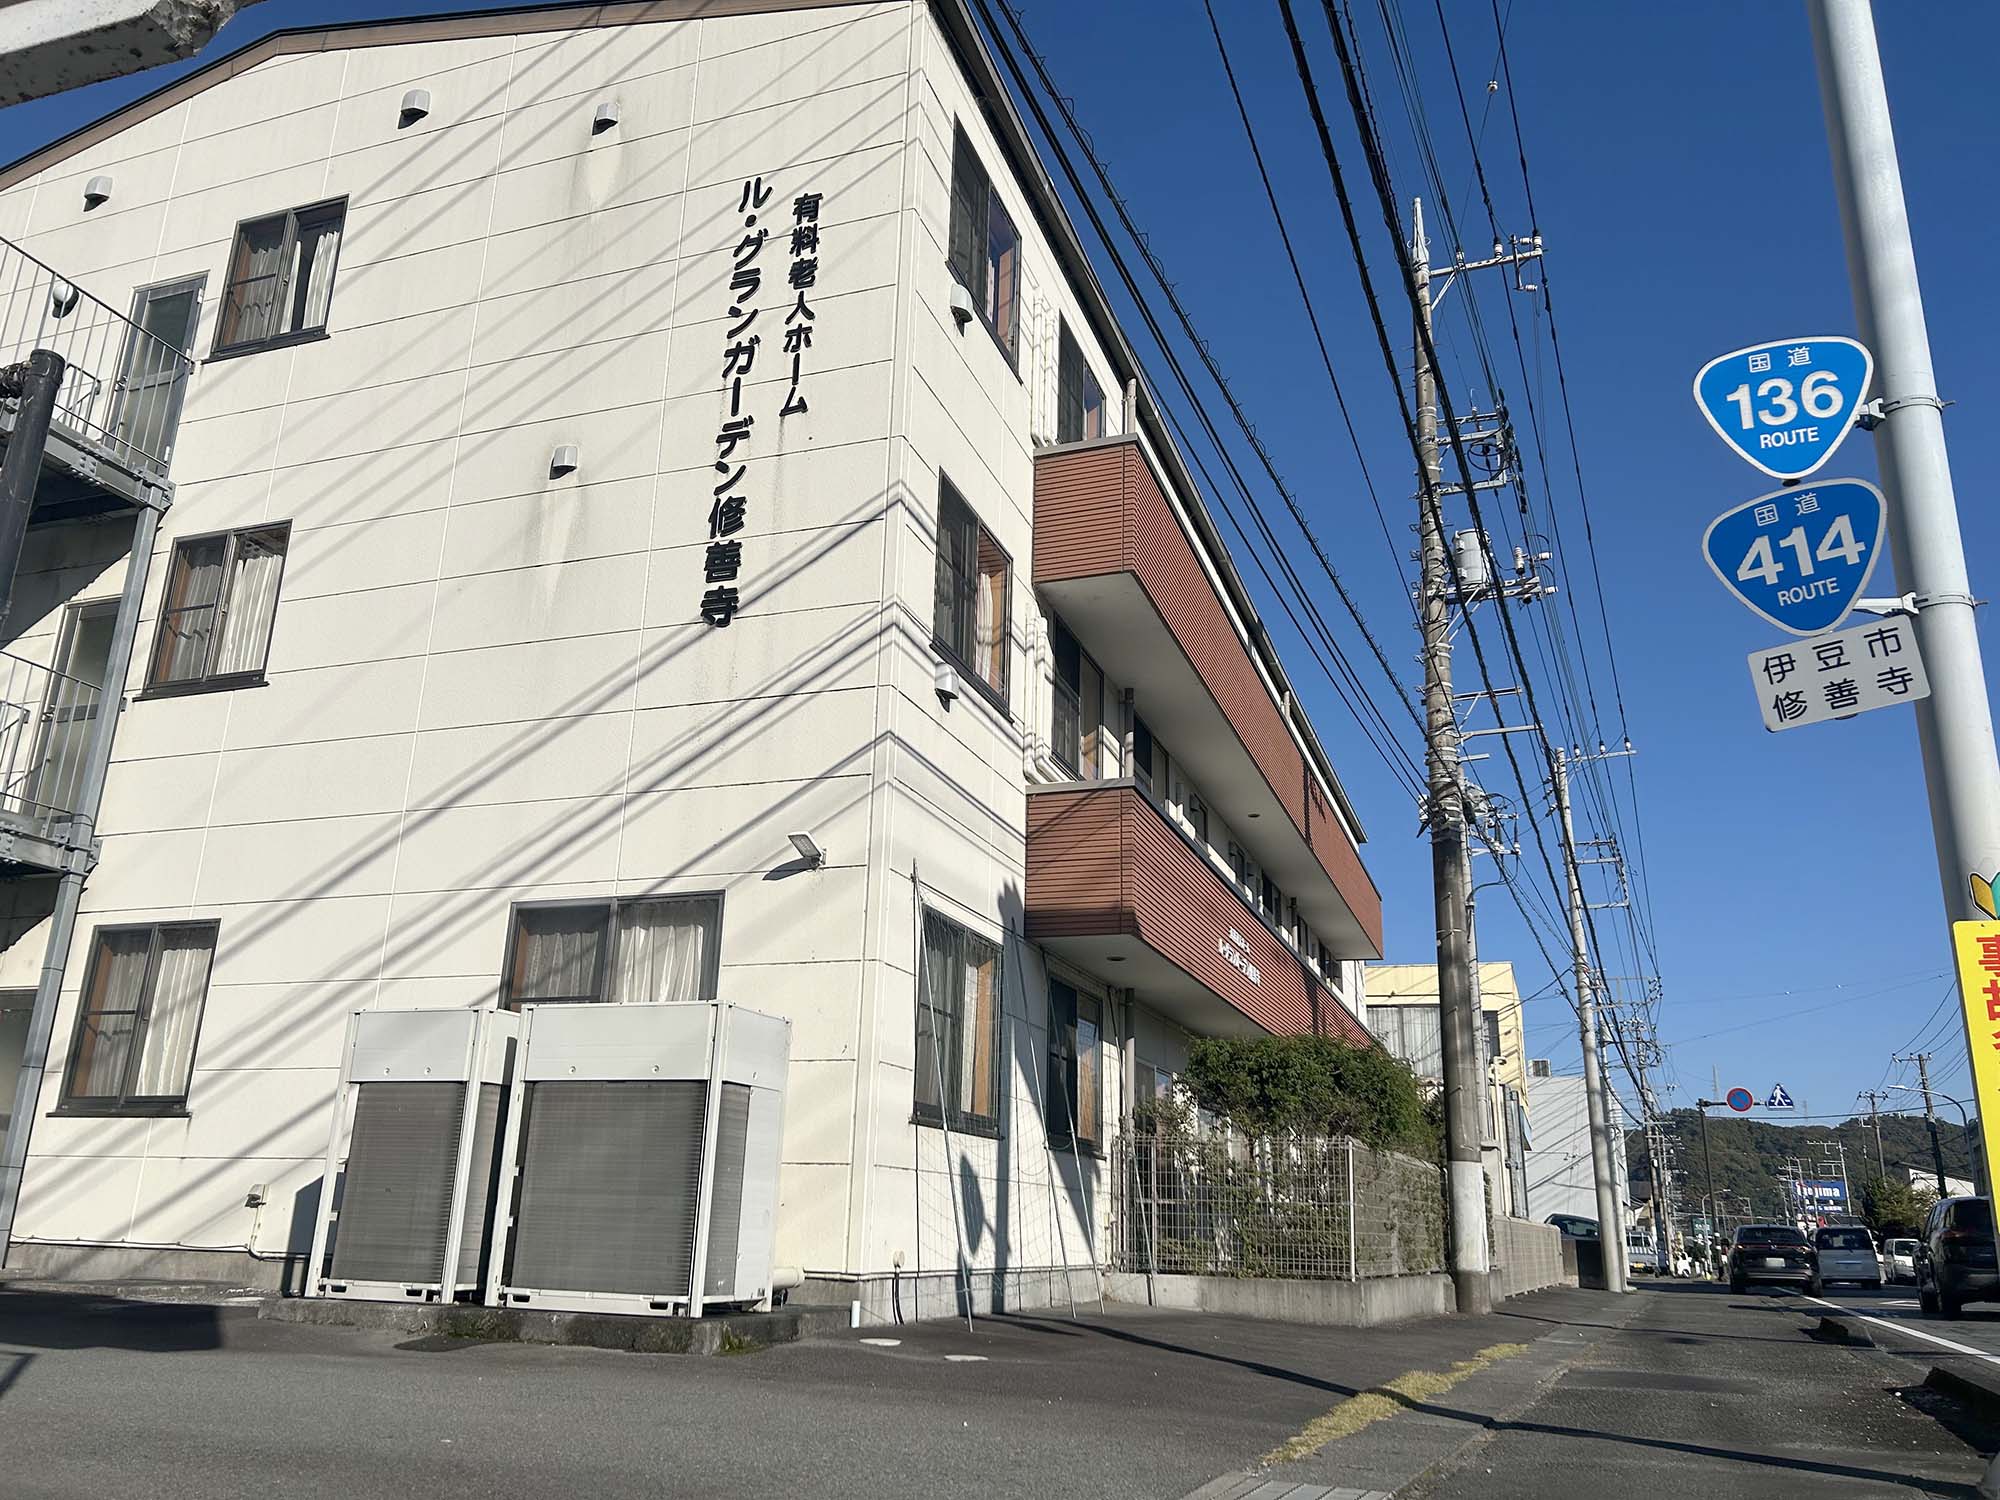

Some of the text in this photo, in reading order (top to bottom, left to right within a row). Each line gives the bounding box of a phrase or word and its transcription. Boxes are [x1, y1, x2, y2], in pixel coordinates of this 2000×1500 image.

[779, 192, 823, 417] 有料老人ホーム
[1748, 345, 1812, 373] 国道
[700, 177, 773, 628] ル・グランガーデン修善寺
[1726, 369, 1844, 431] 136
[1759, 427, 1820, 449] ROUTE
[1754, 493, 1821, 527] 国道
[1736, 514, 1866, 586] 414
[1777, 577, 1840, 607] ROUTE
[1762, 625, 1903, 685] 伊豆市
[1771, 666, 1914, 723] 修善寺
